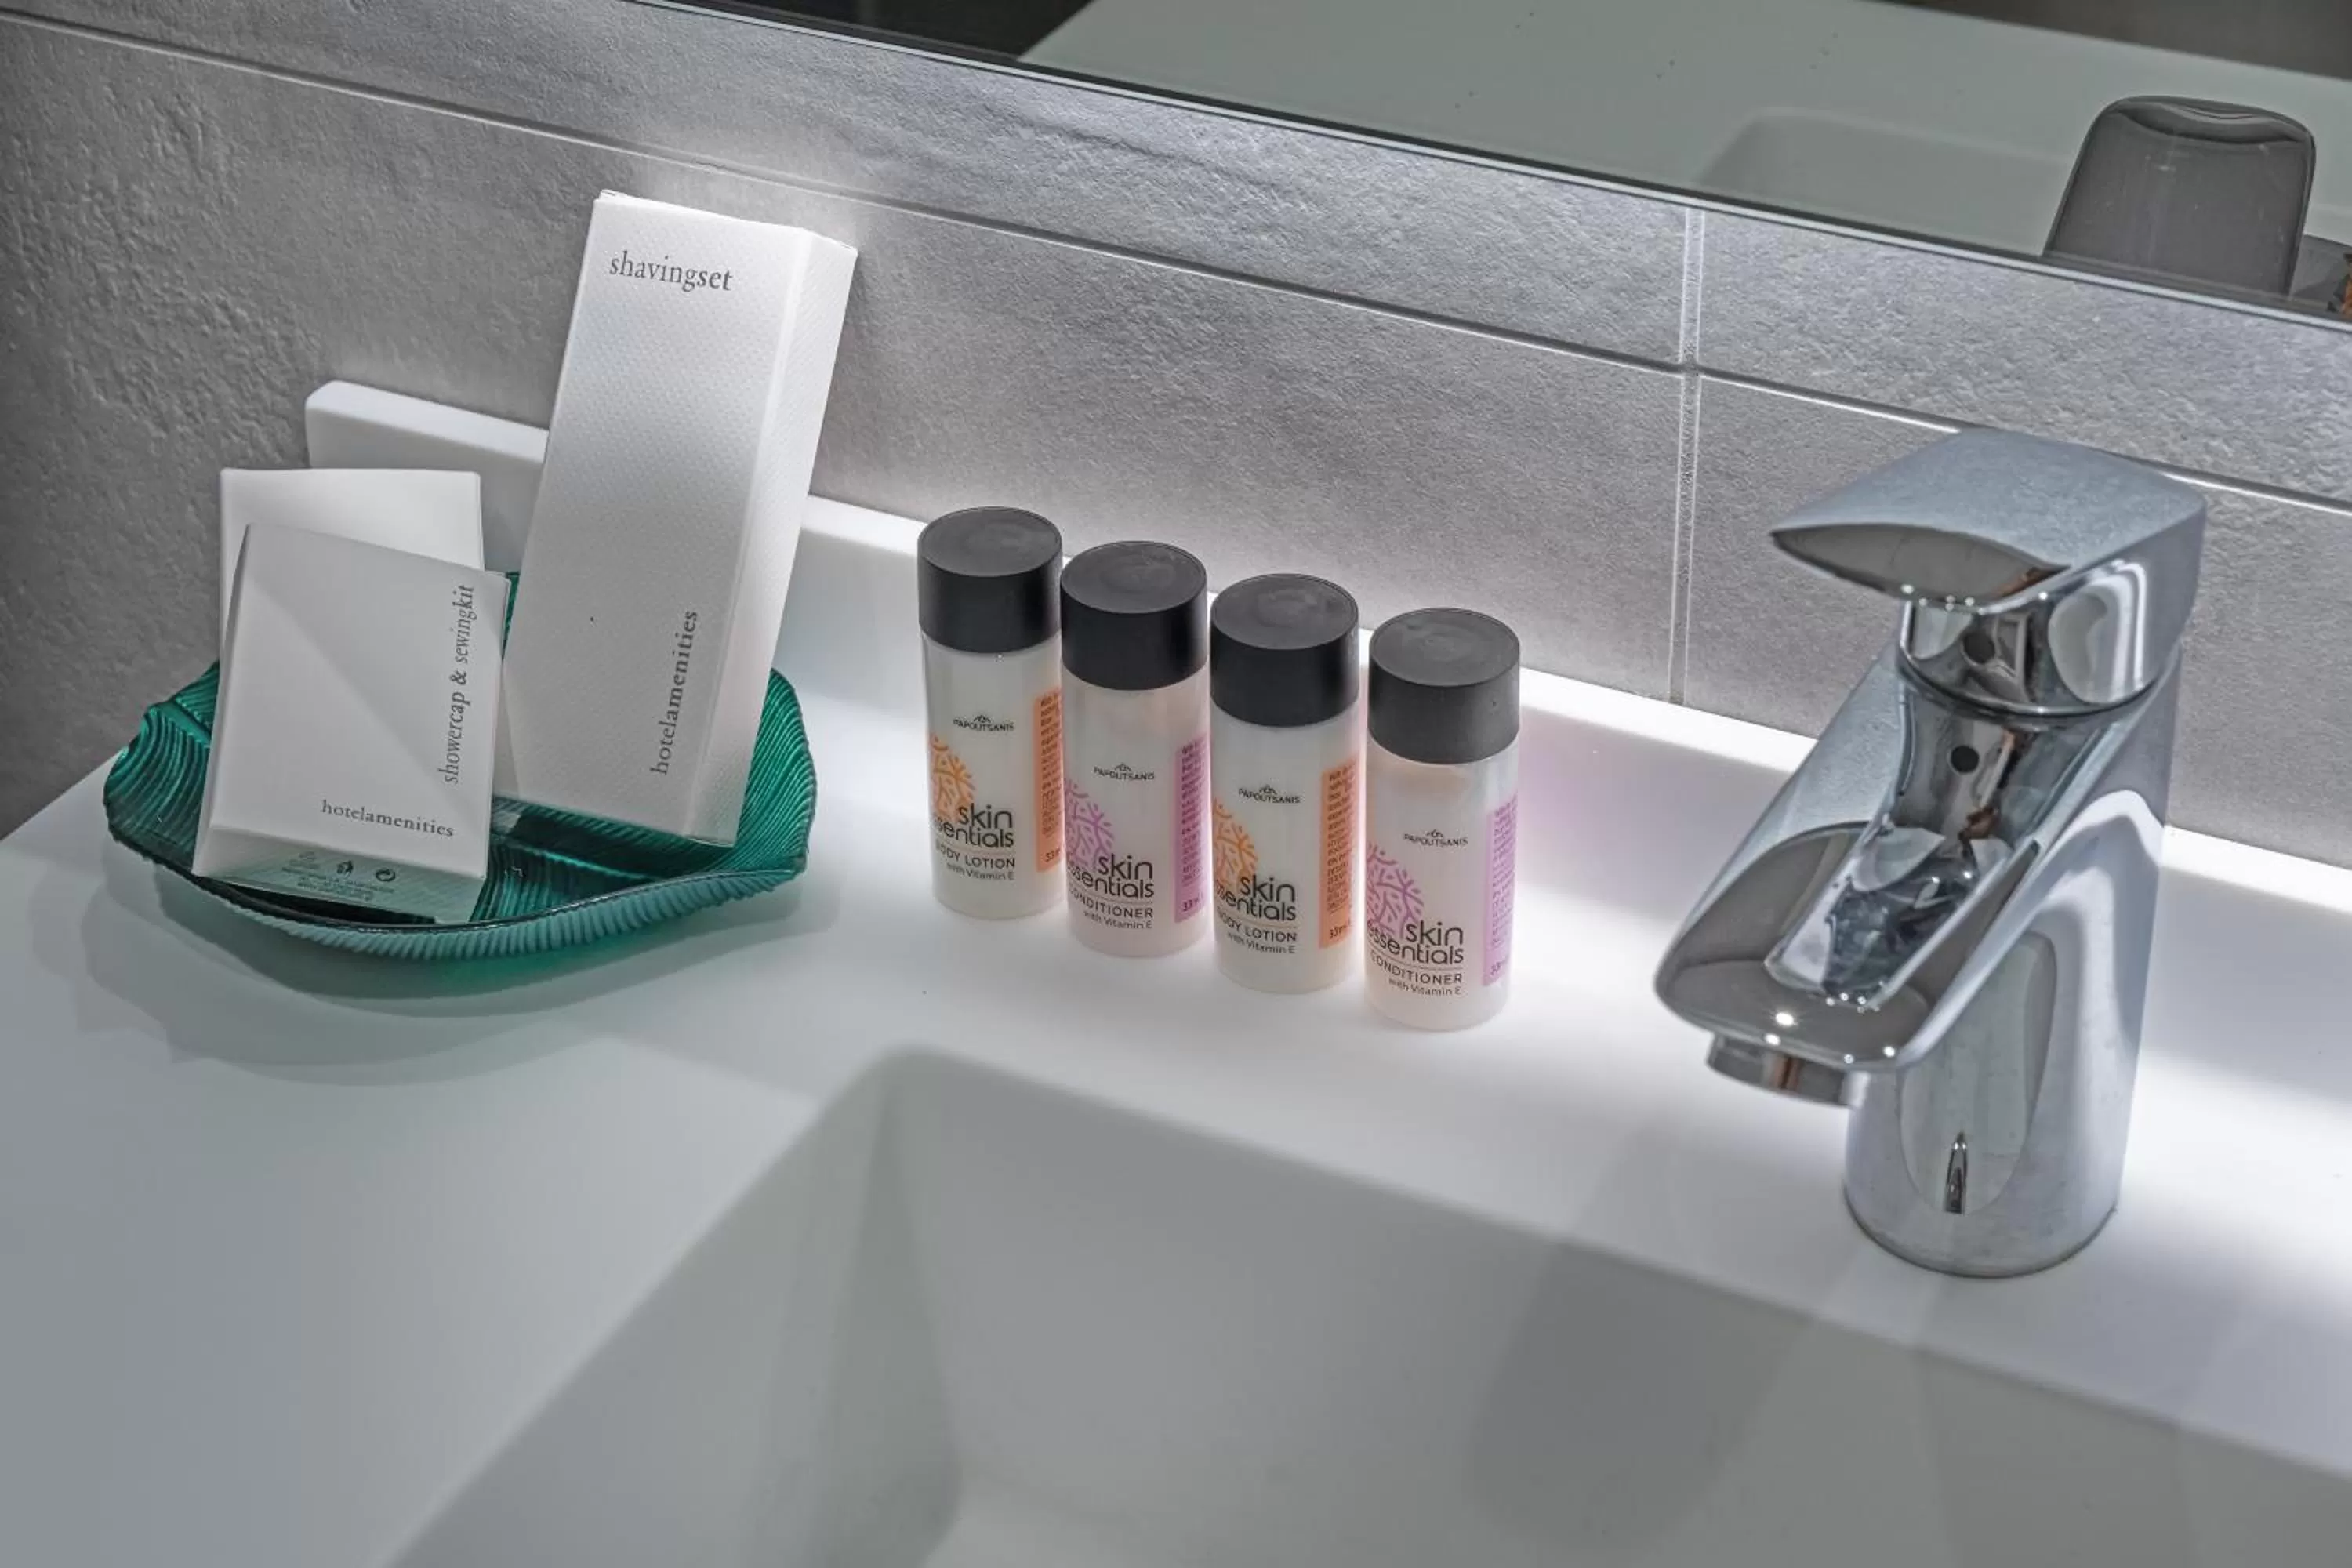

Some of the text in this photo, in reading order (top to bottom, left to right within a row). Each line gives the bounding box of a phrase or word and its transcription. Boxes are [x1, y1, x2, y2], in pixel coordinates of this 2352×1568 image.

[608, 250, 733, 292] shavingset
[437, 584, 477, 785] showercap & sewingkit
[649, 611, 699, 776] hotelamenities
[953, 718, 1015, 731] PAPOUTSANIS
[1094, 765, 1155, 781] PAPOUTSANIS
[1238, 787, 1301, 804] PAPOUTSANIS
[320, 799, 454, 837] hotelamenities
[958, 802, 1013, 829] skin
[1403, 833, 1468, 847] PAPOUTSANIS
[965, 855, 1016, 869] LOTION
[1098, 852, 1154, 880] skin
[965, 868, 1007, 881] Vitamin
[1008, 871, 1015, 880] E
[1240, 873, 1296, 903] skin
[1102, 916, 1145, 929] Vitamin
[1146, 920, 1152, 929] E
[1244, 927, 1298, 943] LOTION
[1406, 920, 1464, 946] skin
[1247, 938, 1287, 954] Vitamin
[1289, 945, 1296, 954] E
[1370, 949, 1463, 985] CONDITIONER
[1411, 984, 1453, 996] Vitamin
[1454, 986, 1462, 995] E
